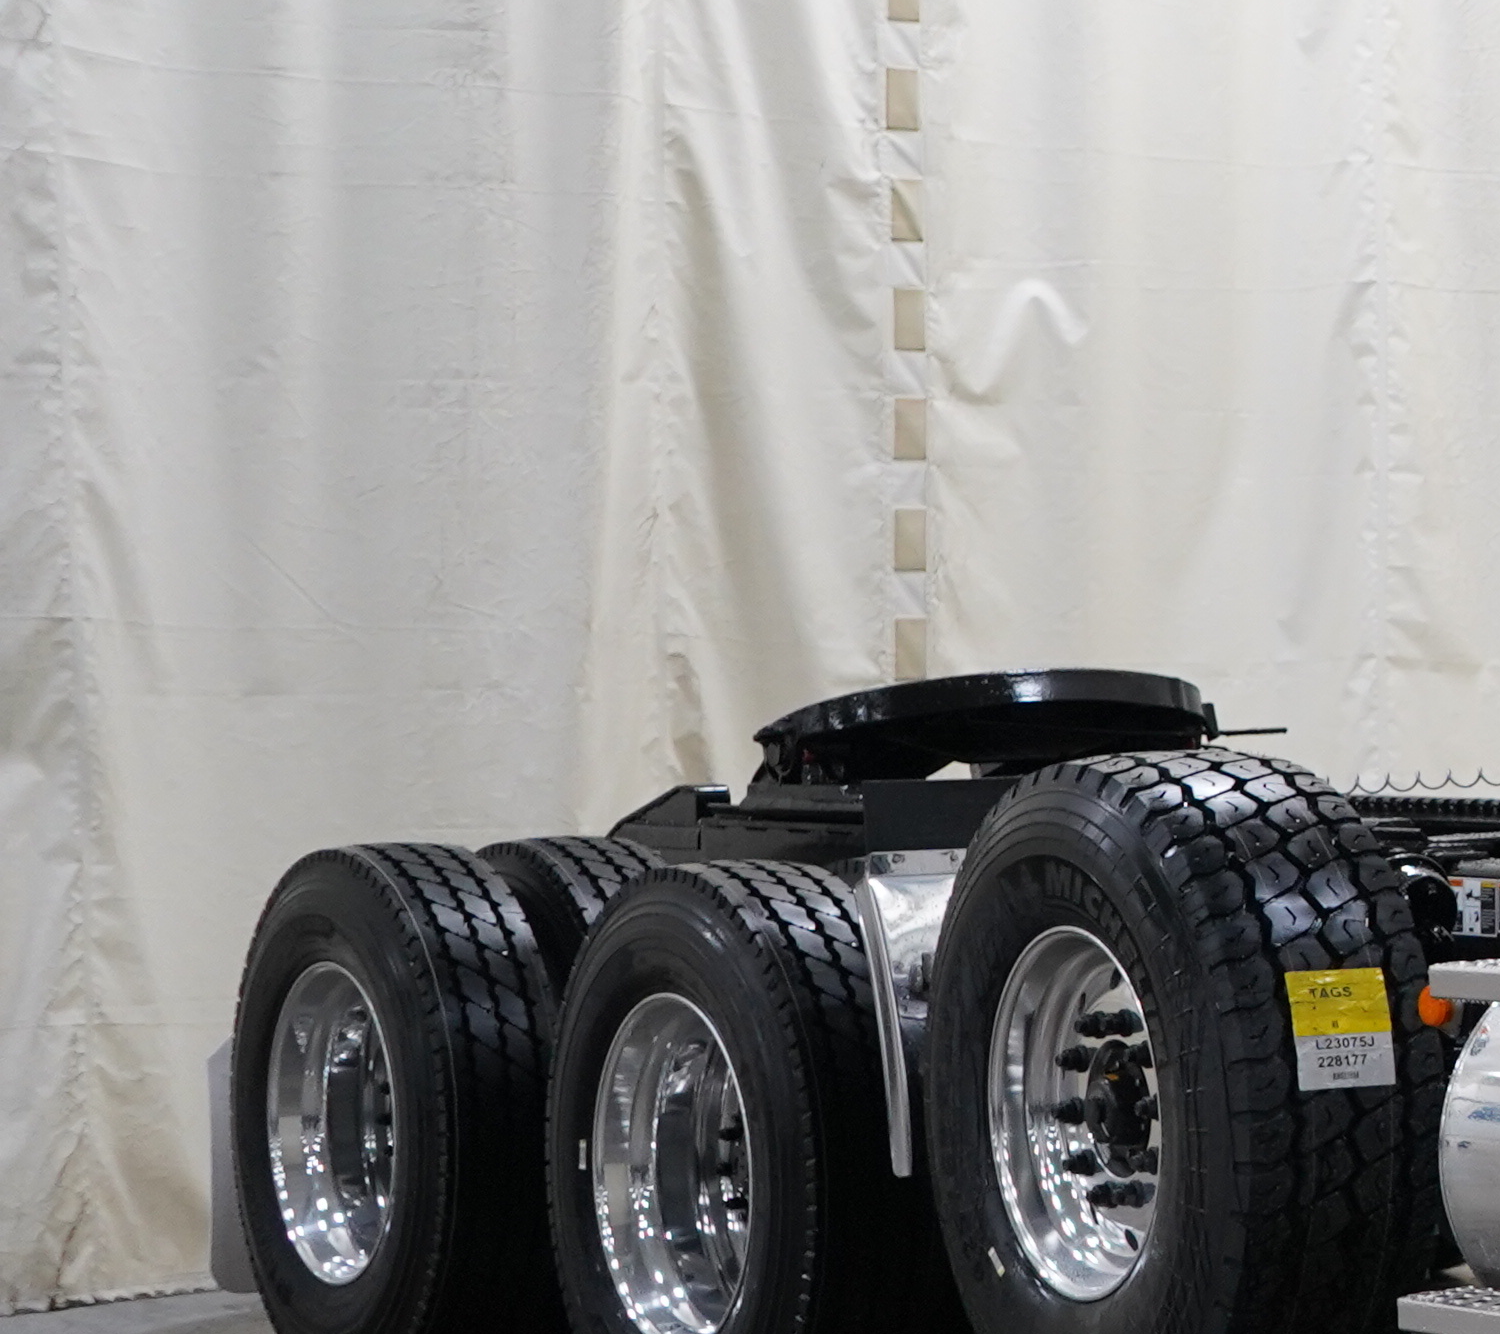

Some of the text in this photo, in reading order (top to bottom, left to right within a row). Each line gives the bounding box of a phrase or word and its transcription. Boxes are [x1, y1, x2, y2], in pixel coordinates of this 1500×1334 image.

[1309, 986, 1352, 999] TAGS
[1316, 1036, 1375, 1050] L23075J
[1318, 1054, 1367, 1068] 228177
